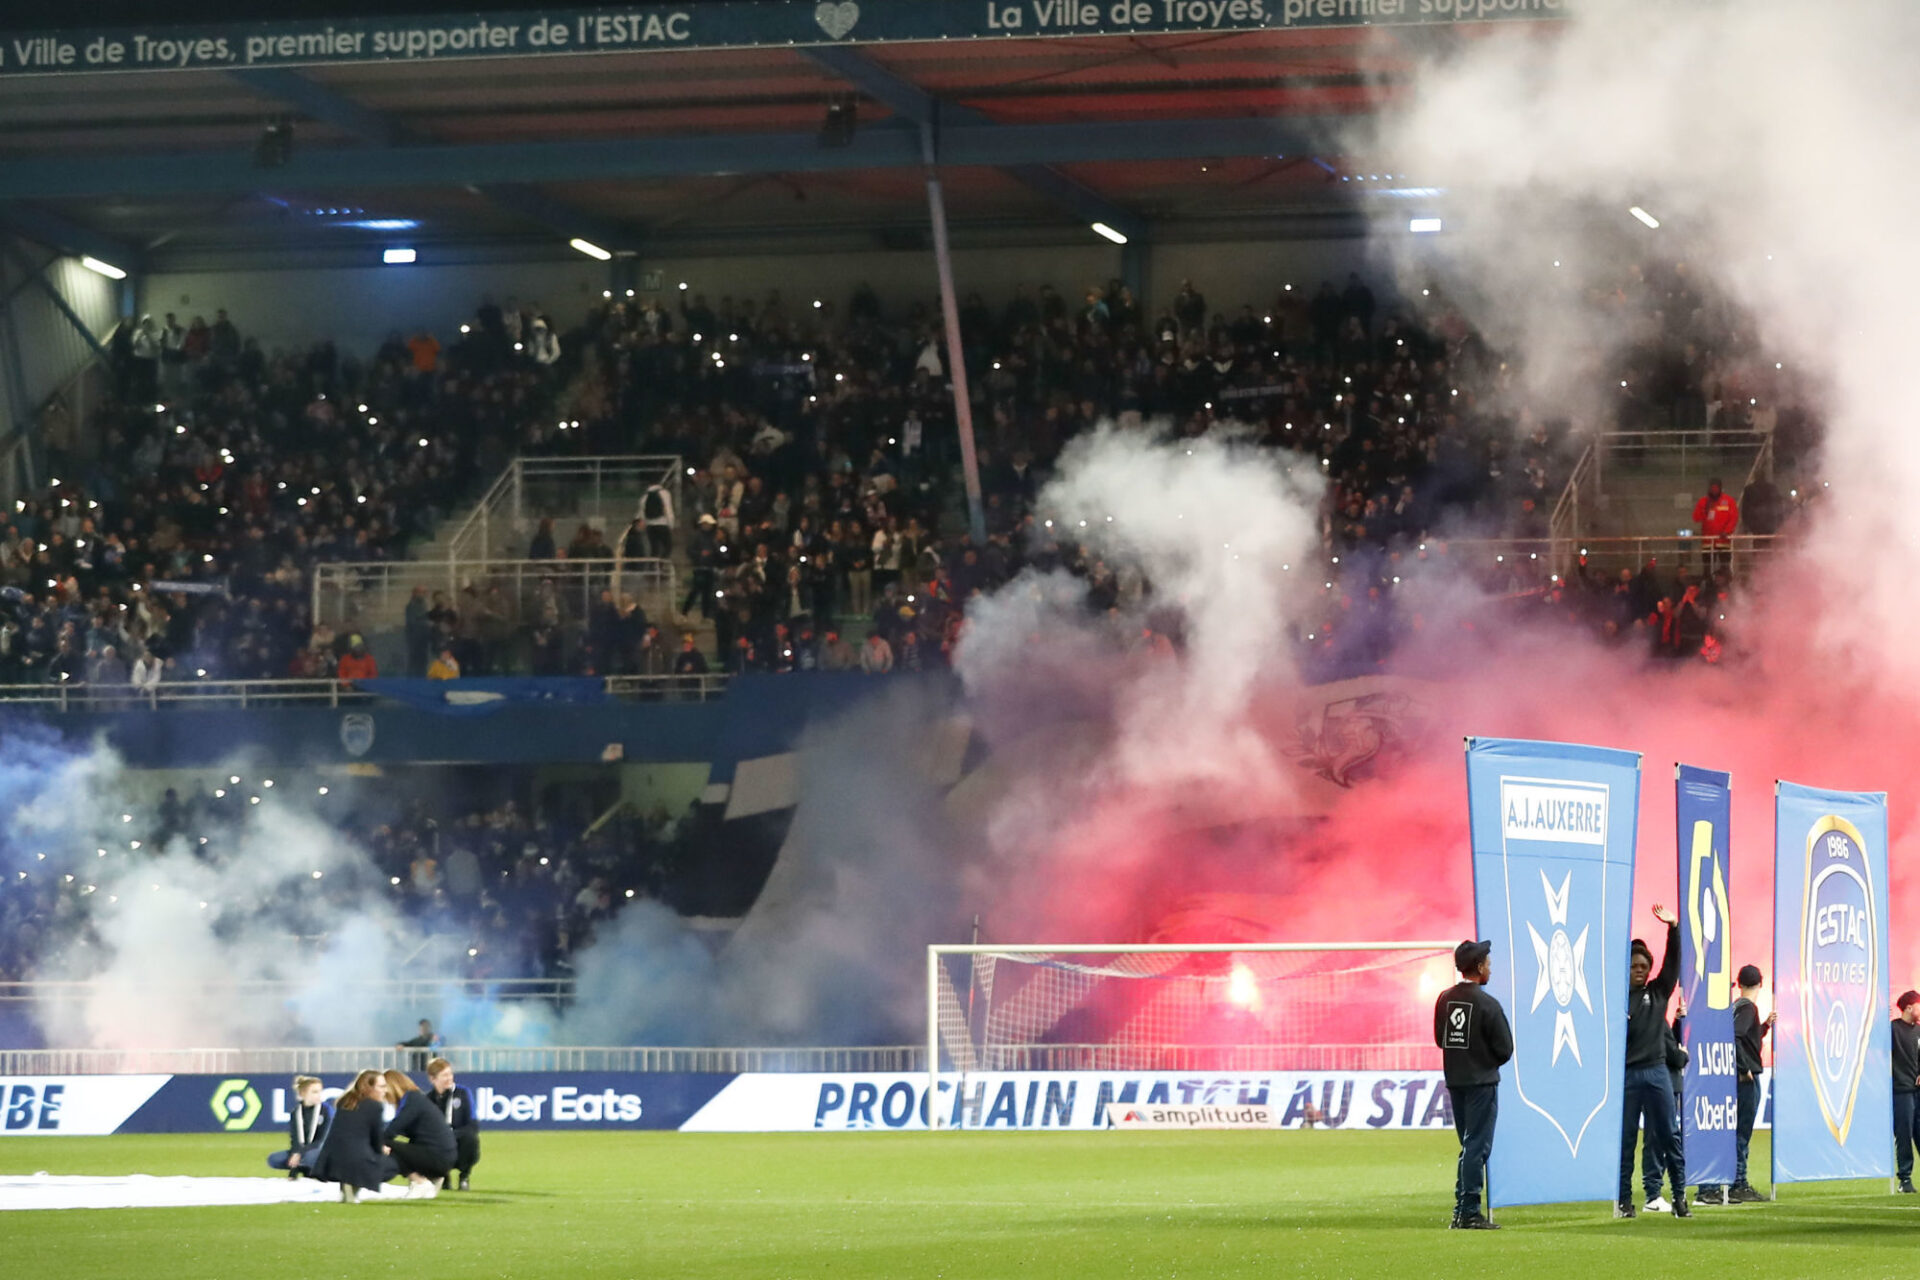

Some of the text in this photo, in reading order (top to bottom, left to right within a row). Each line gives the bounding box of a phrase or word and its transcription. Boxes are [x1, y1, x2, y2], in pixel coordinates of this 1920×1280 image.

[988, 0, 1566, 28] La Ville de Troyes, premier suppore
[14, 37, 75, 65] Ville
[85, 36, 125, 63] de
[133, 35, 236, 66] Troyes,
[247, 27, 365, 63] premier
[373, 21, 519, 57] supporter
[528, 18, 569, 46] de
[577, 12, 690, 44] l'ESTAC
[1507, 797, 1602, 833] A.J.AUXERRE
[1827, 835, 1850, 860] 1986
[1816, 903, 1866, 948] ESTAC
[1815, 961, 1866, 984] TROYES
[1829, 1021, 1845, 1059] 10
[1697, 1042, 1735, 1076] LIGUE
[0, 1085, 65, 1130] BE
[552, 1087, 642, 1121] Eats
[814, 1080, 1077, 1129] PROCHAIN
[1281, 1079, 1355, 1128] AU
[1366, 1079, 1455, 1128] STA
[1152, 1107, 1269, 1126] amplitude
[1695, 1096, 1725, 1130] Uber
